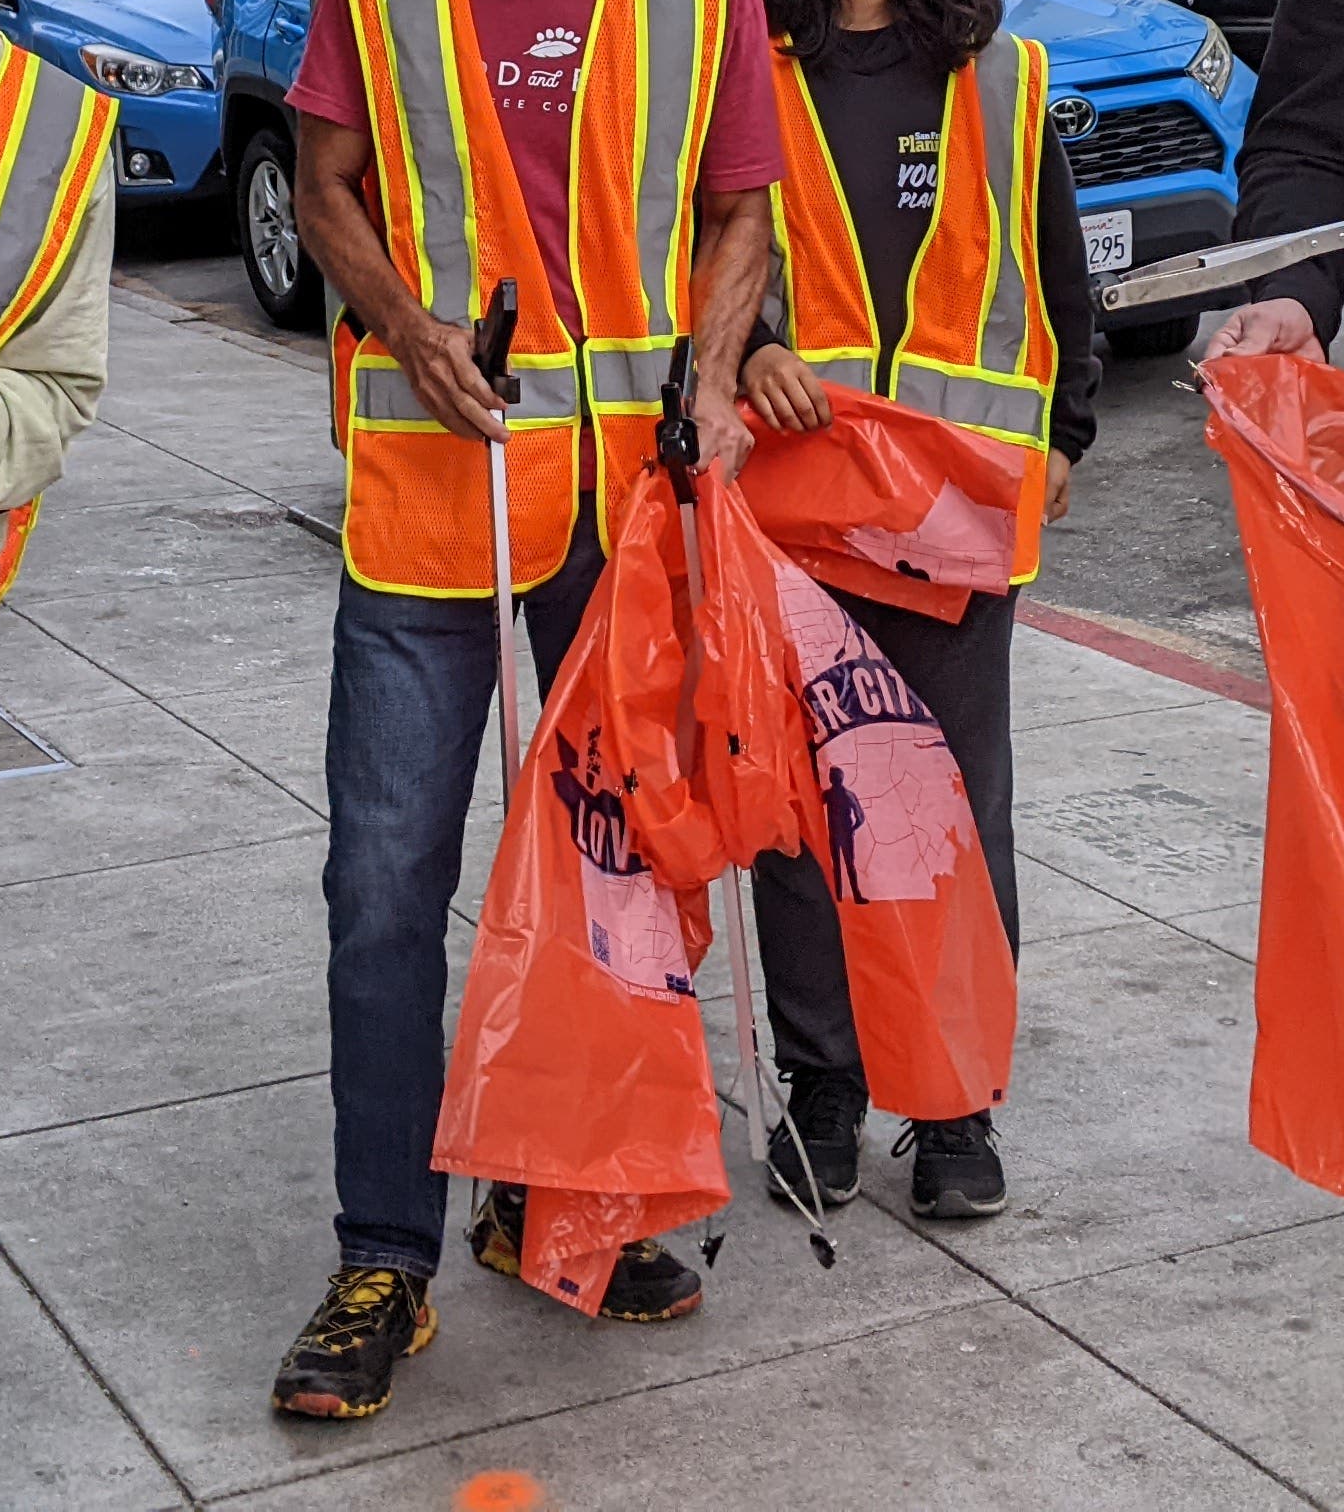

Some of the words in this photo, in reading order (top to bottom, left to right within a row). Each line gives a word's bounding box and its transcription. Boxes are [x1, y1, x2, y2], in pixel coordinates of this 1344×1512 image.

[527, 70, 564, 88] and
[914, 131, 929, 140] San
[1089, 233, 1125, 265] 295
[576, 797, 646, 872] LOV
